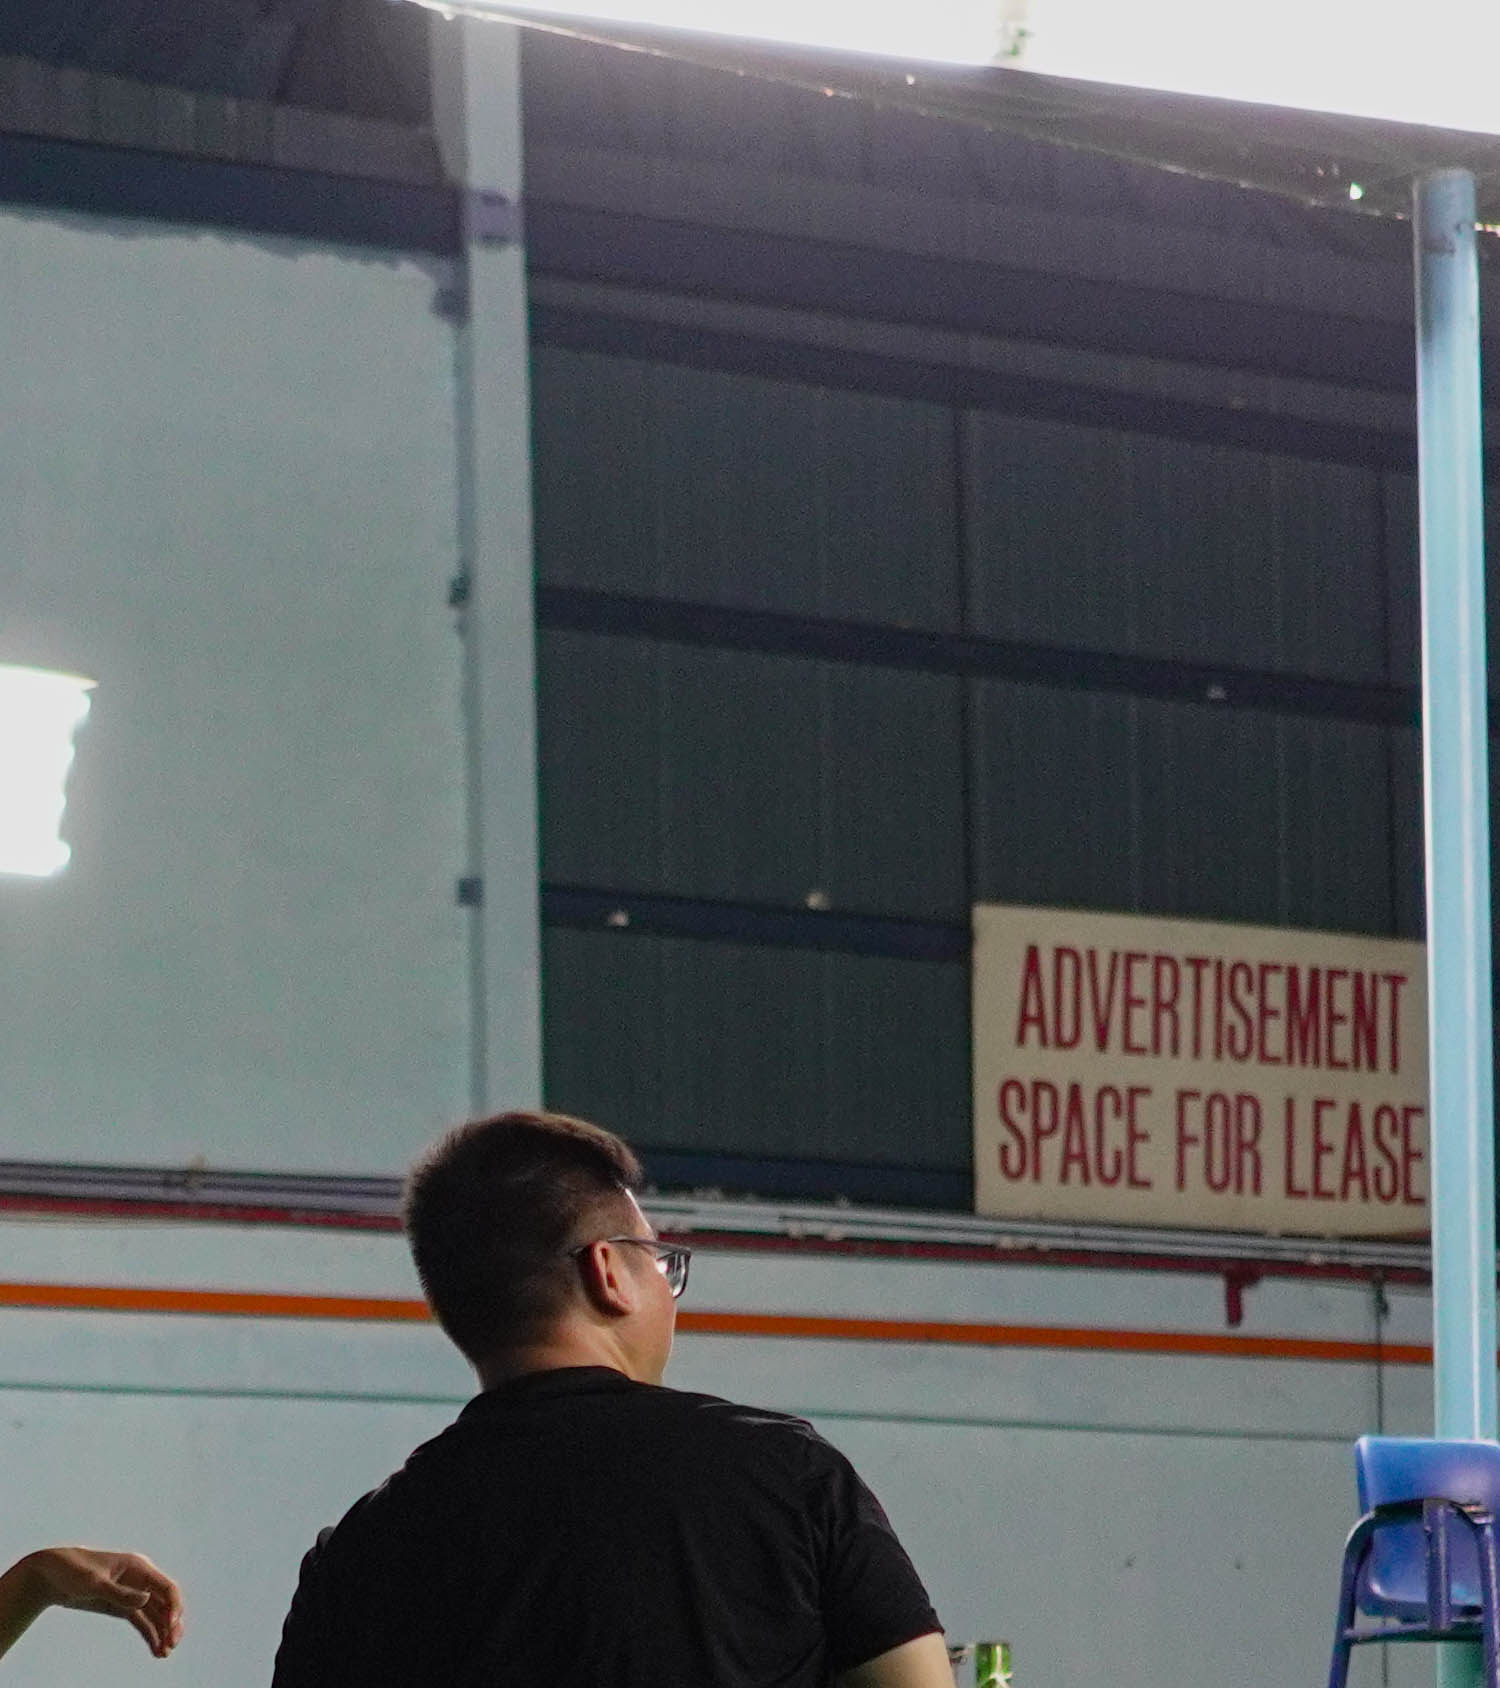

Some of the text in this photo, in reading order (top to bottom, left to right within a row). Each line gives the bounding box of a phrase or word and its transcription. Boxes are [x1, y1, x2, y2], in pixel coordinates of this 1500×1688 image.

[1016, 944, 1410, 1074] ADVERTISEMENT
[998, 1078, 1427, 1207] SPACE FOR LEASE
